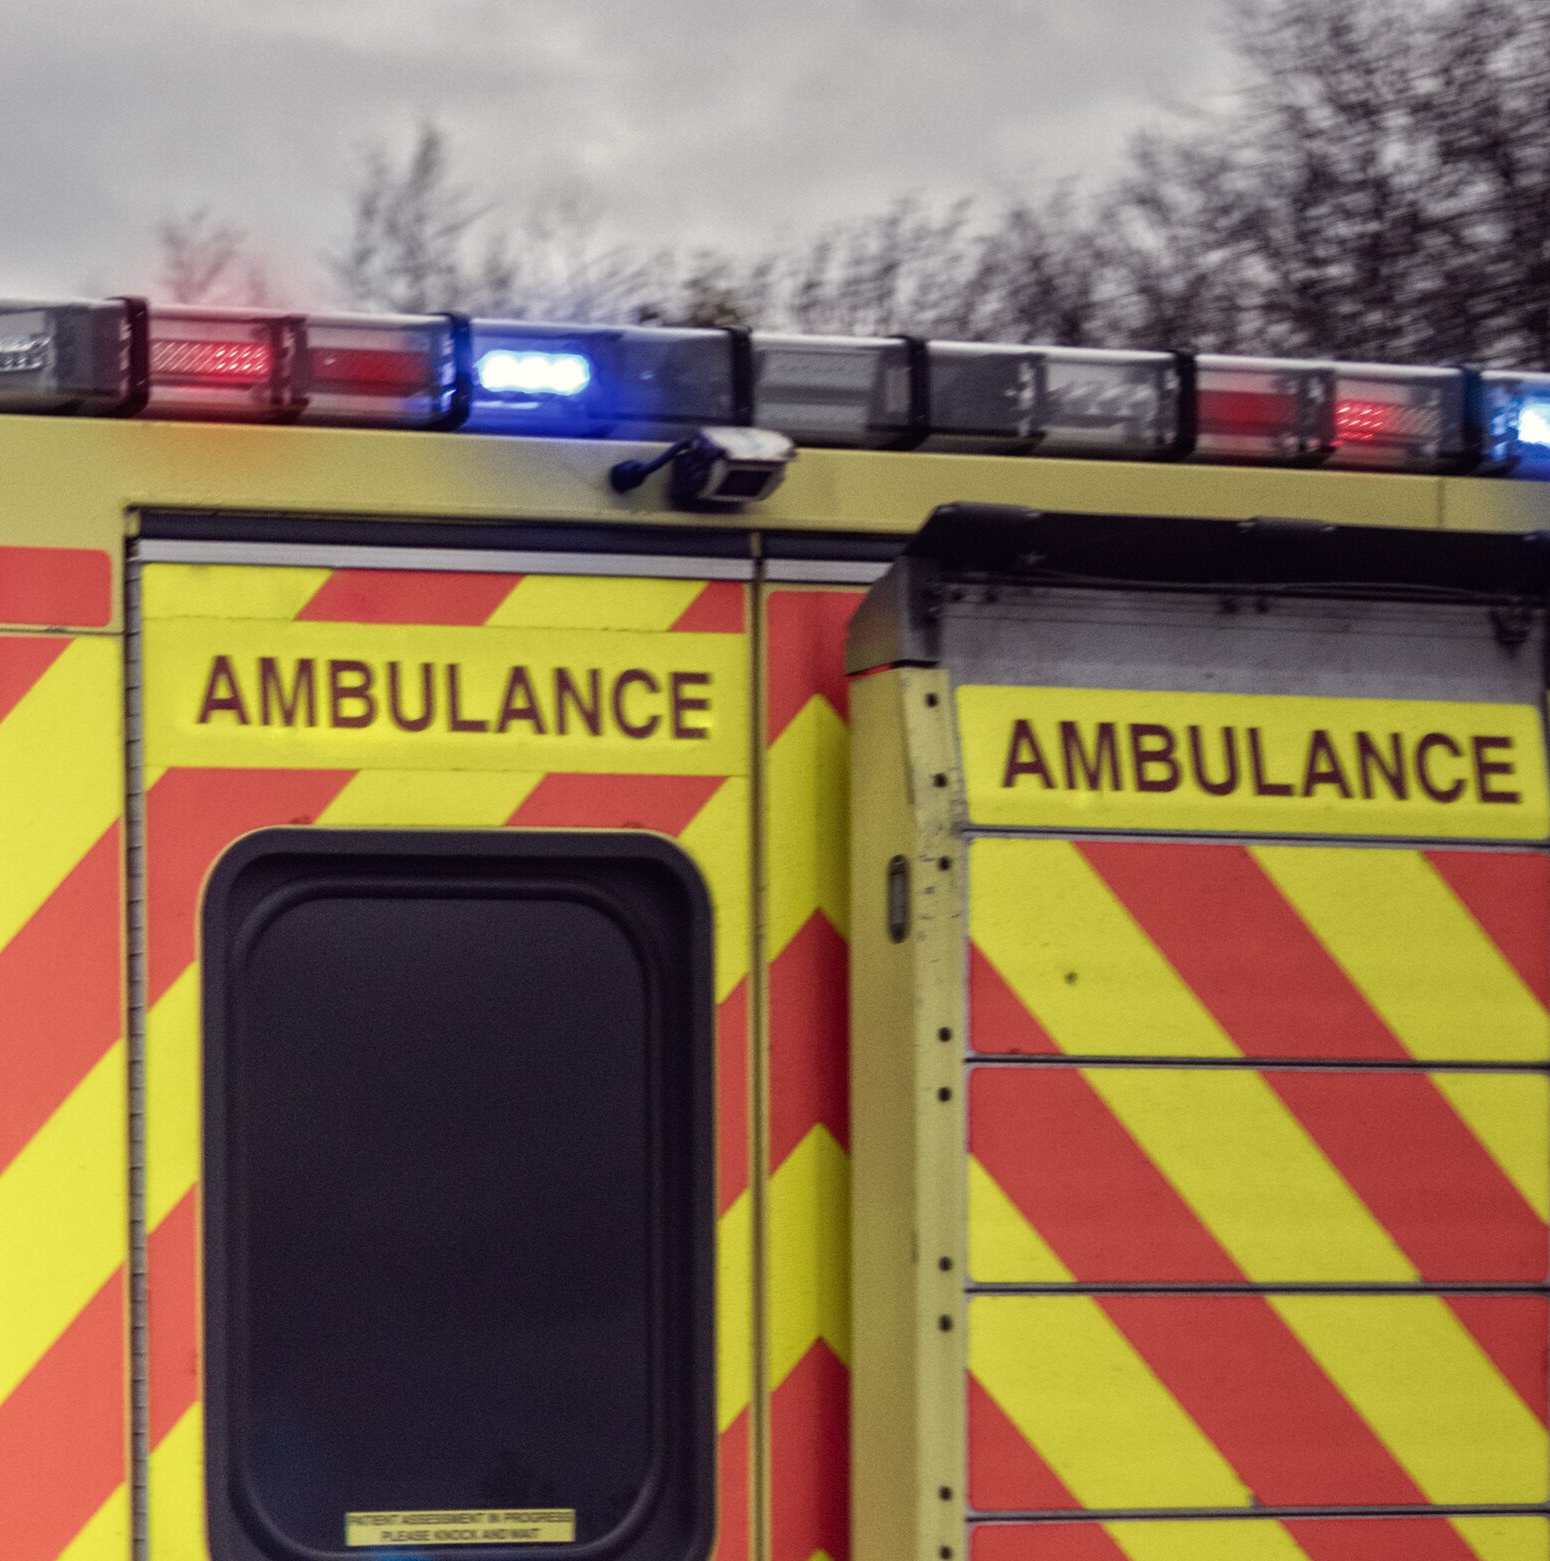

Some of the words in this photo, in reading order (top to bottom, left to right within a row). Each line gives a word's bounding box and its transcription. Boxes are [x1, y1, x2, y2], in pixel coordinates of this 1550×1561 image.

[196, 655, 711, 740] AMBULANCE
[1001, 719, 1522, 804] AMBULANCE
[381, 1530, 430, 1541] PLEASE
[434, 1529, 478, 1540] KNOCK
[482, 1529, 506, 1540] AND
[511, 1528, 541, 1539] WAIT
